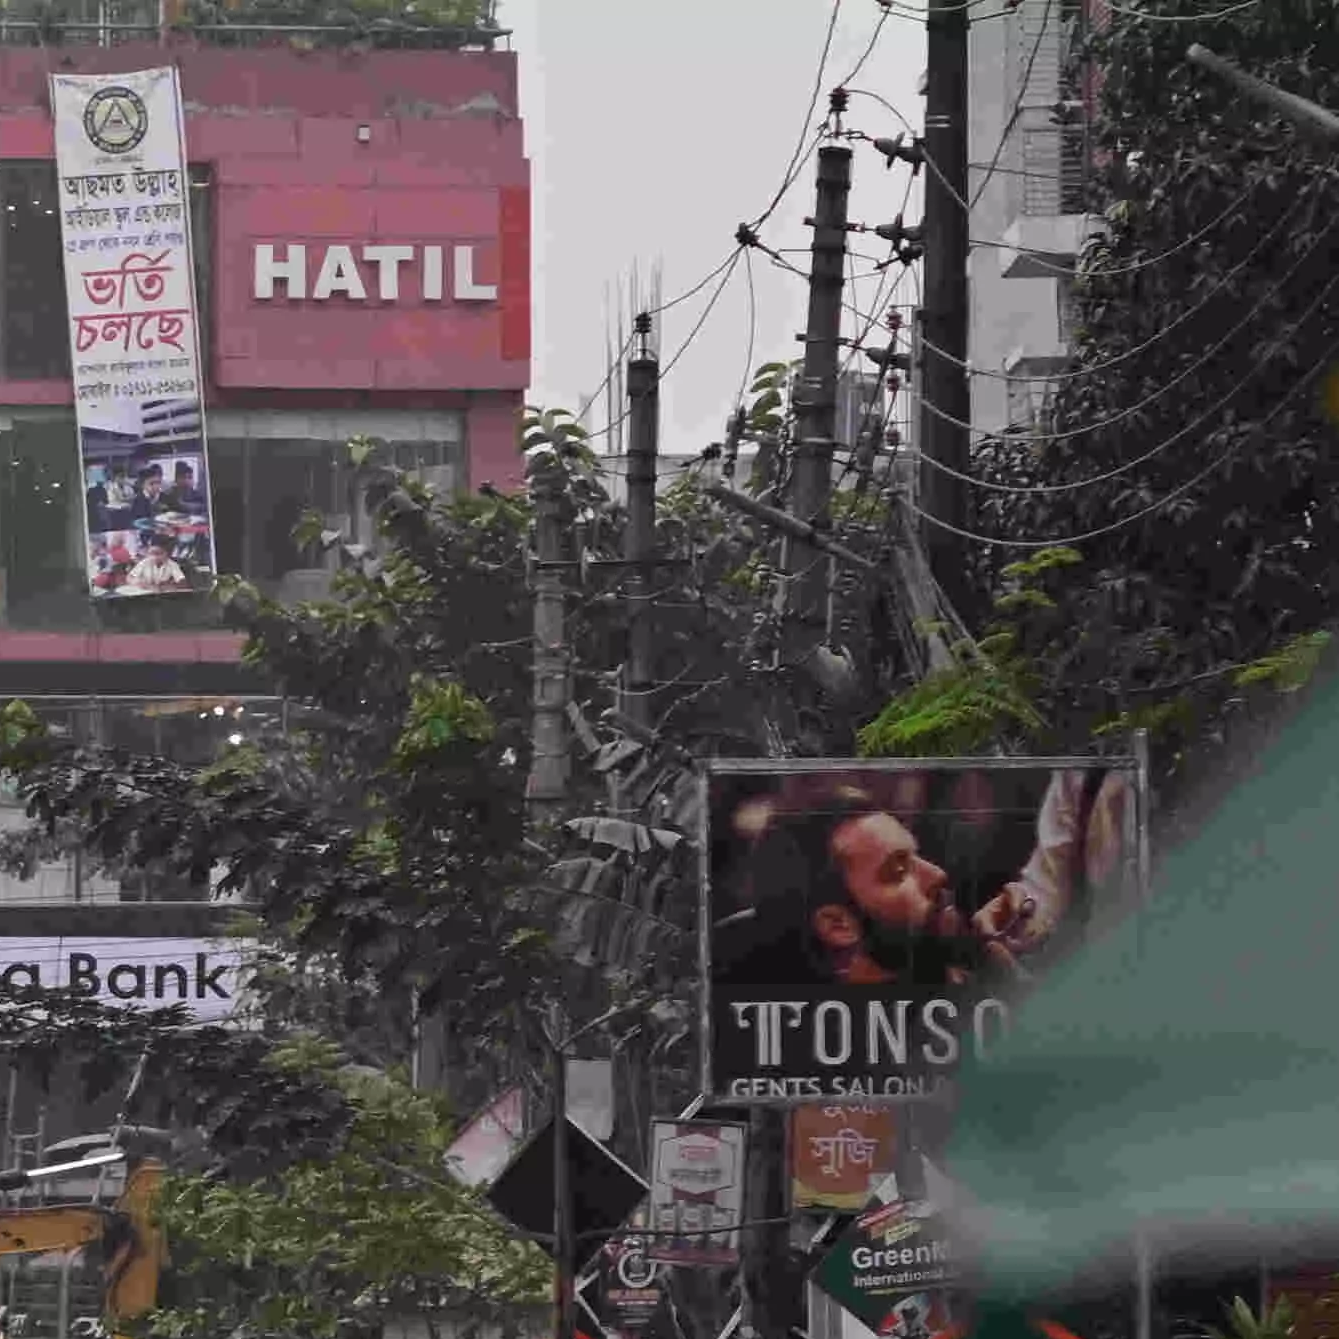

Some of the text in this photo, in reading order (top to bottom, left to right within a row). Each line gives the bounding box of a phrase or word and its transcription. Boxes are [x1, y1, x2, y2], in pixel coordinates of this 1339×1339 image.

[80, 248, 175, 309] ভর্তি
[254, 244, 498, 301] HATIL
[72, 309, 191, 352] চলছে
[69, 952, 229, 998] Bank
[809, 1127, 880, 1178] সুজি
